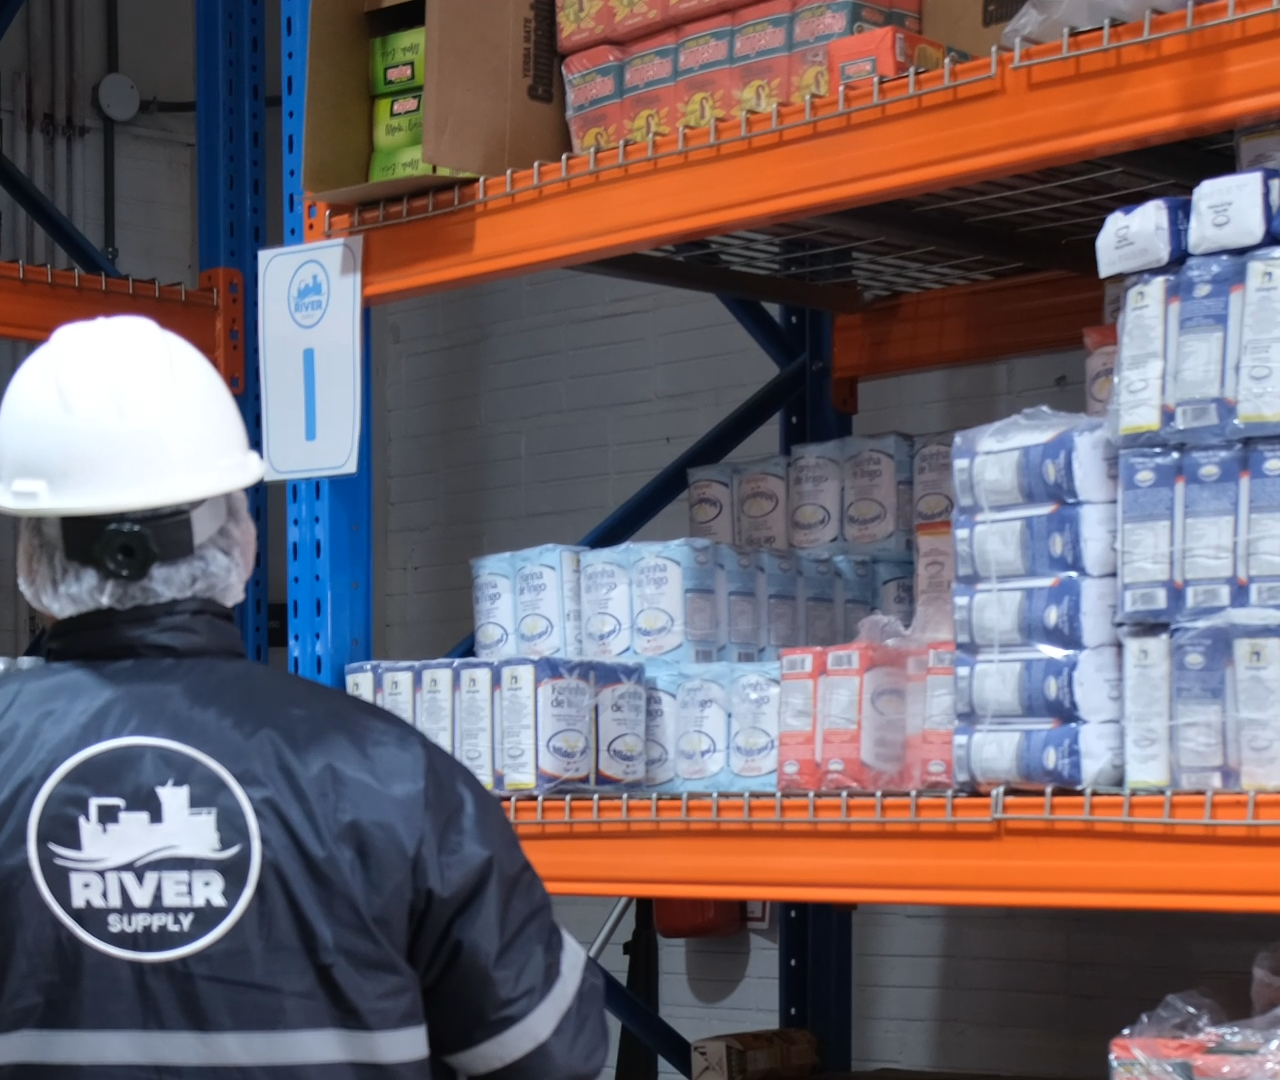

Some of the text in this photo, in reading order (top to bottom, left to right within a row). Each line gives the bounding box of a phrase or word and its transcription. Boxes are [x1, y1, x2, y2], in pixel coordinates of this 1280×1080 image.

[522, 17, 533, 79] YERBA MATE
[293, 301, 324, 314] RIVER
[68, 870, 229, 909] RIVER
[106, 912, 195, 933] SUPPLY
